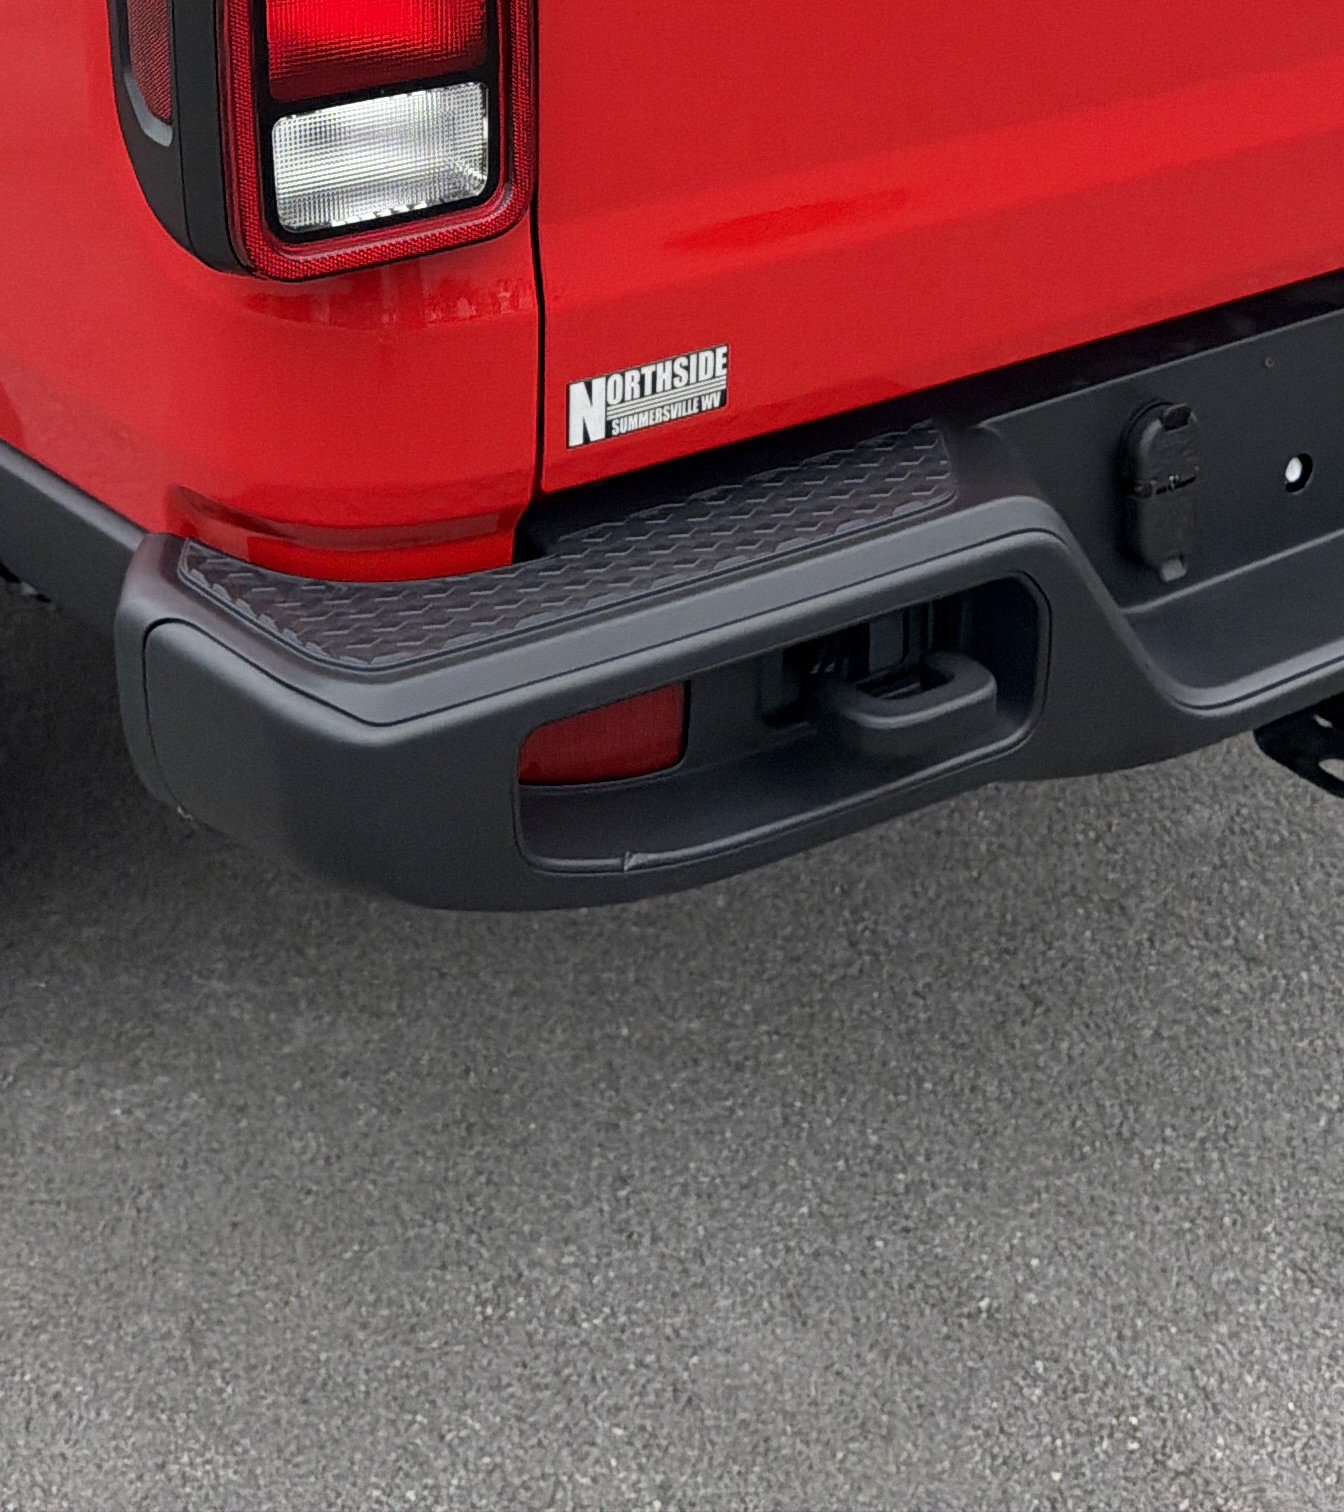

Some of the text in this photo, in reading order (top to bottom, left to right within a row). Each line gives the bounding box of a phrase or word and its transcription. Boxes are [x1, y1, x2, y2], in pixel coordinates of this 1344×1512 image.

[568, 345, 728, 448] NORTHSIDE
[611, 391, 722, 436] SUMMERSVILLE WV
